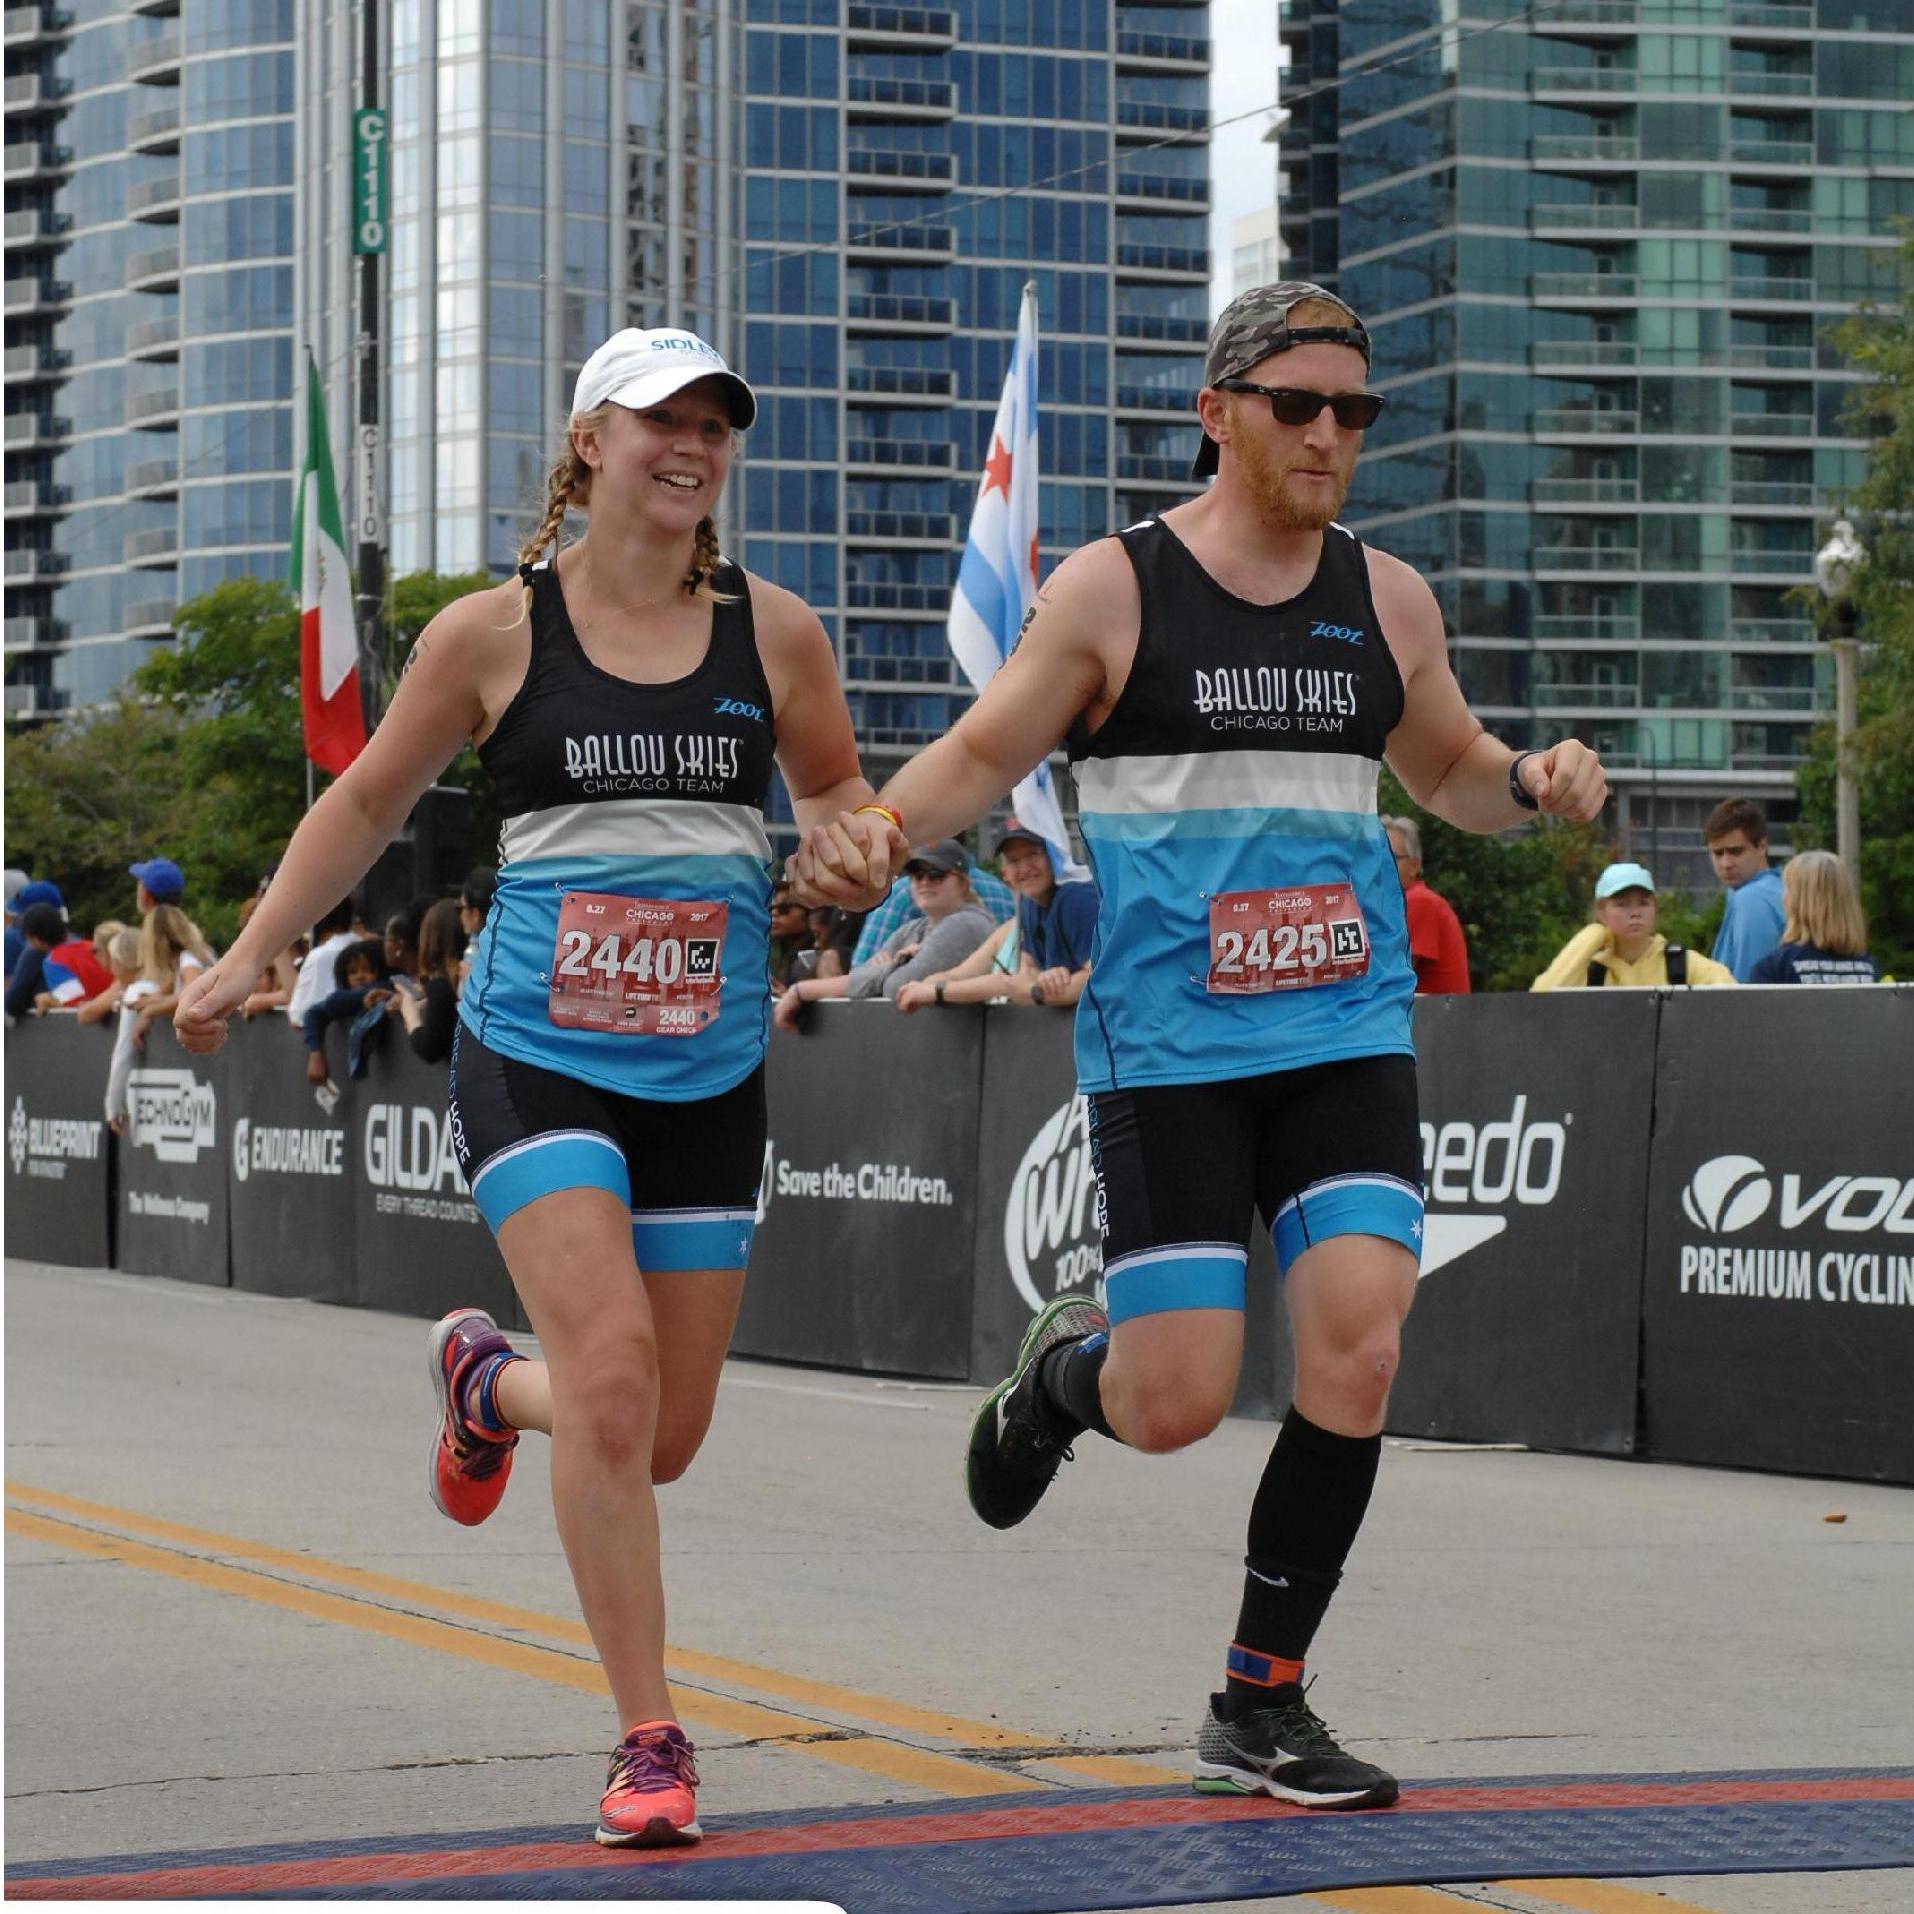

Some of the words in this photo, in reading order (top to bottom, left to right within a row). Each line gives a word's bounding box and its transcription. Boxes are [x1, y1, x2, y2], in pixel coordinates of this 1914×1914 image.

[360, 115, 384, 247] C1110
[364, 428, 377, 536] C1110
[1194, 666, 1287, 713] BALLOU
[1295, 668, 1356, 715] SKIES
[1211, 715, 1290, 730] CHICAGO
[1296, 717, 1343, 732] TEAM
[564, 734, 666, 779] BALLOU
[674, 735, 738, 779] SKIES
[583, 778, 670, 793] CHICAGO
[677, 778, 724, 793] TEAM
[626, 908, 674, 921] CHICAGO
[1268, 897, 1312, 910] CHICAGO
[558, 930, 682, 985] 2440
[1215, 923, 1328, 974] 2425
[656, 1026, 675, 1034] GEAR
[659, 1008, 696, 1025] 2440
[29, 1118, 101, 1159] BLUEPRINT
[251, 1127, 344, 1175] ENDURANCE
[451, 1101, 471, 1165] HOPE
[777, 1159, 821, 1197] Save
[823, 1163, 855, 1199] the
[1680, 1245, 1811, 1300] PREMIUM
